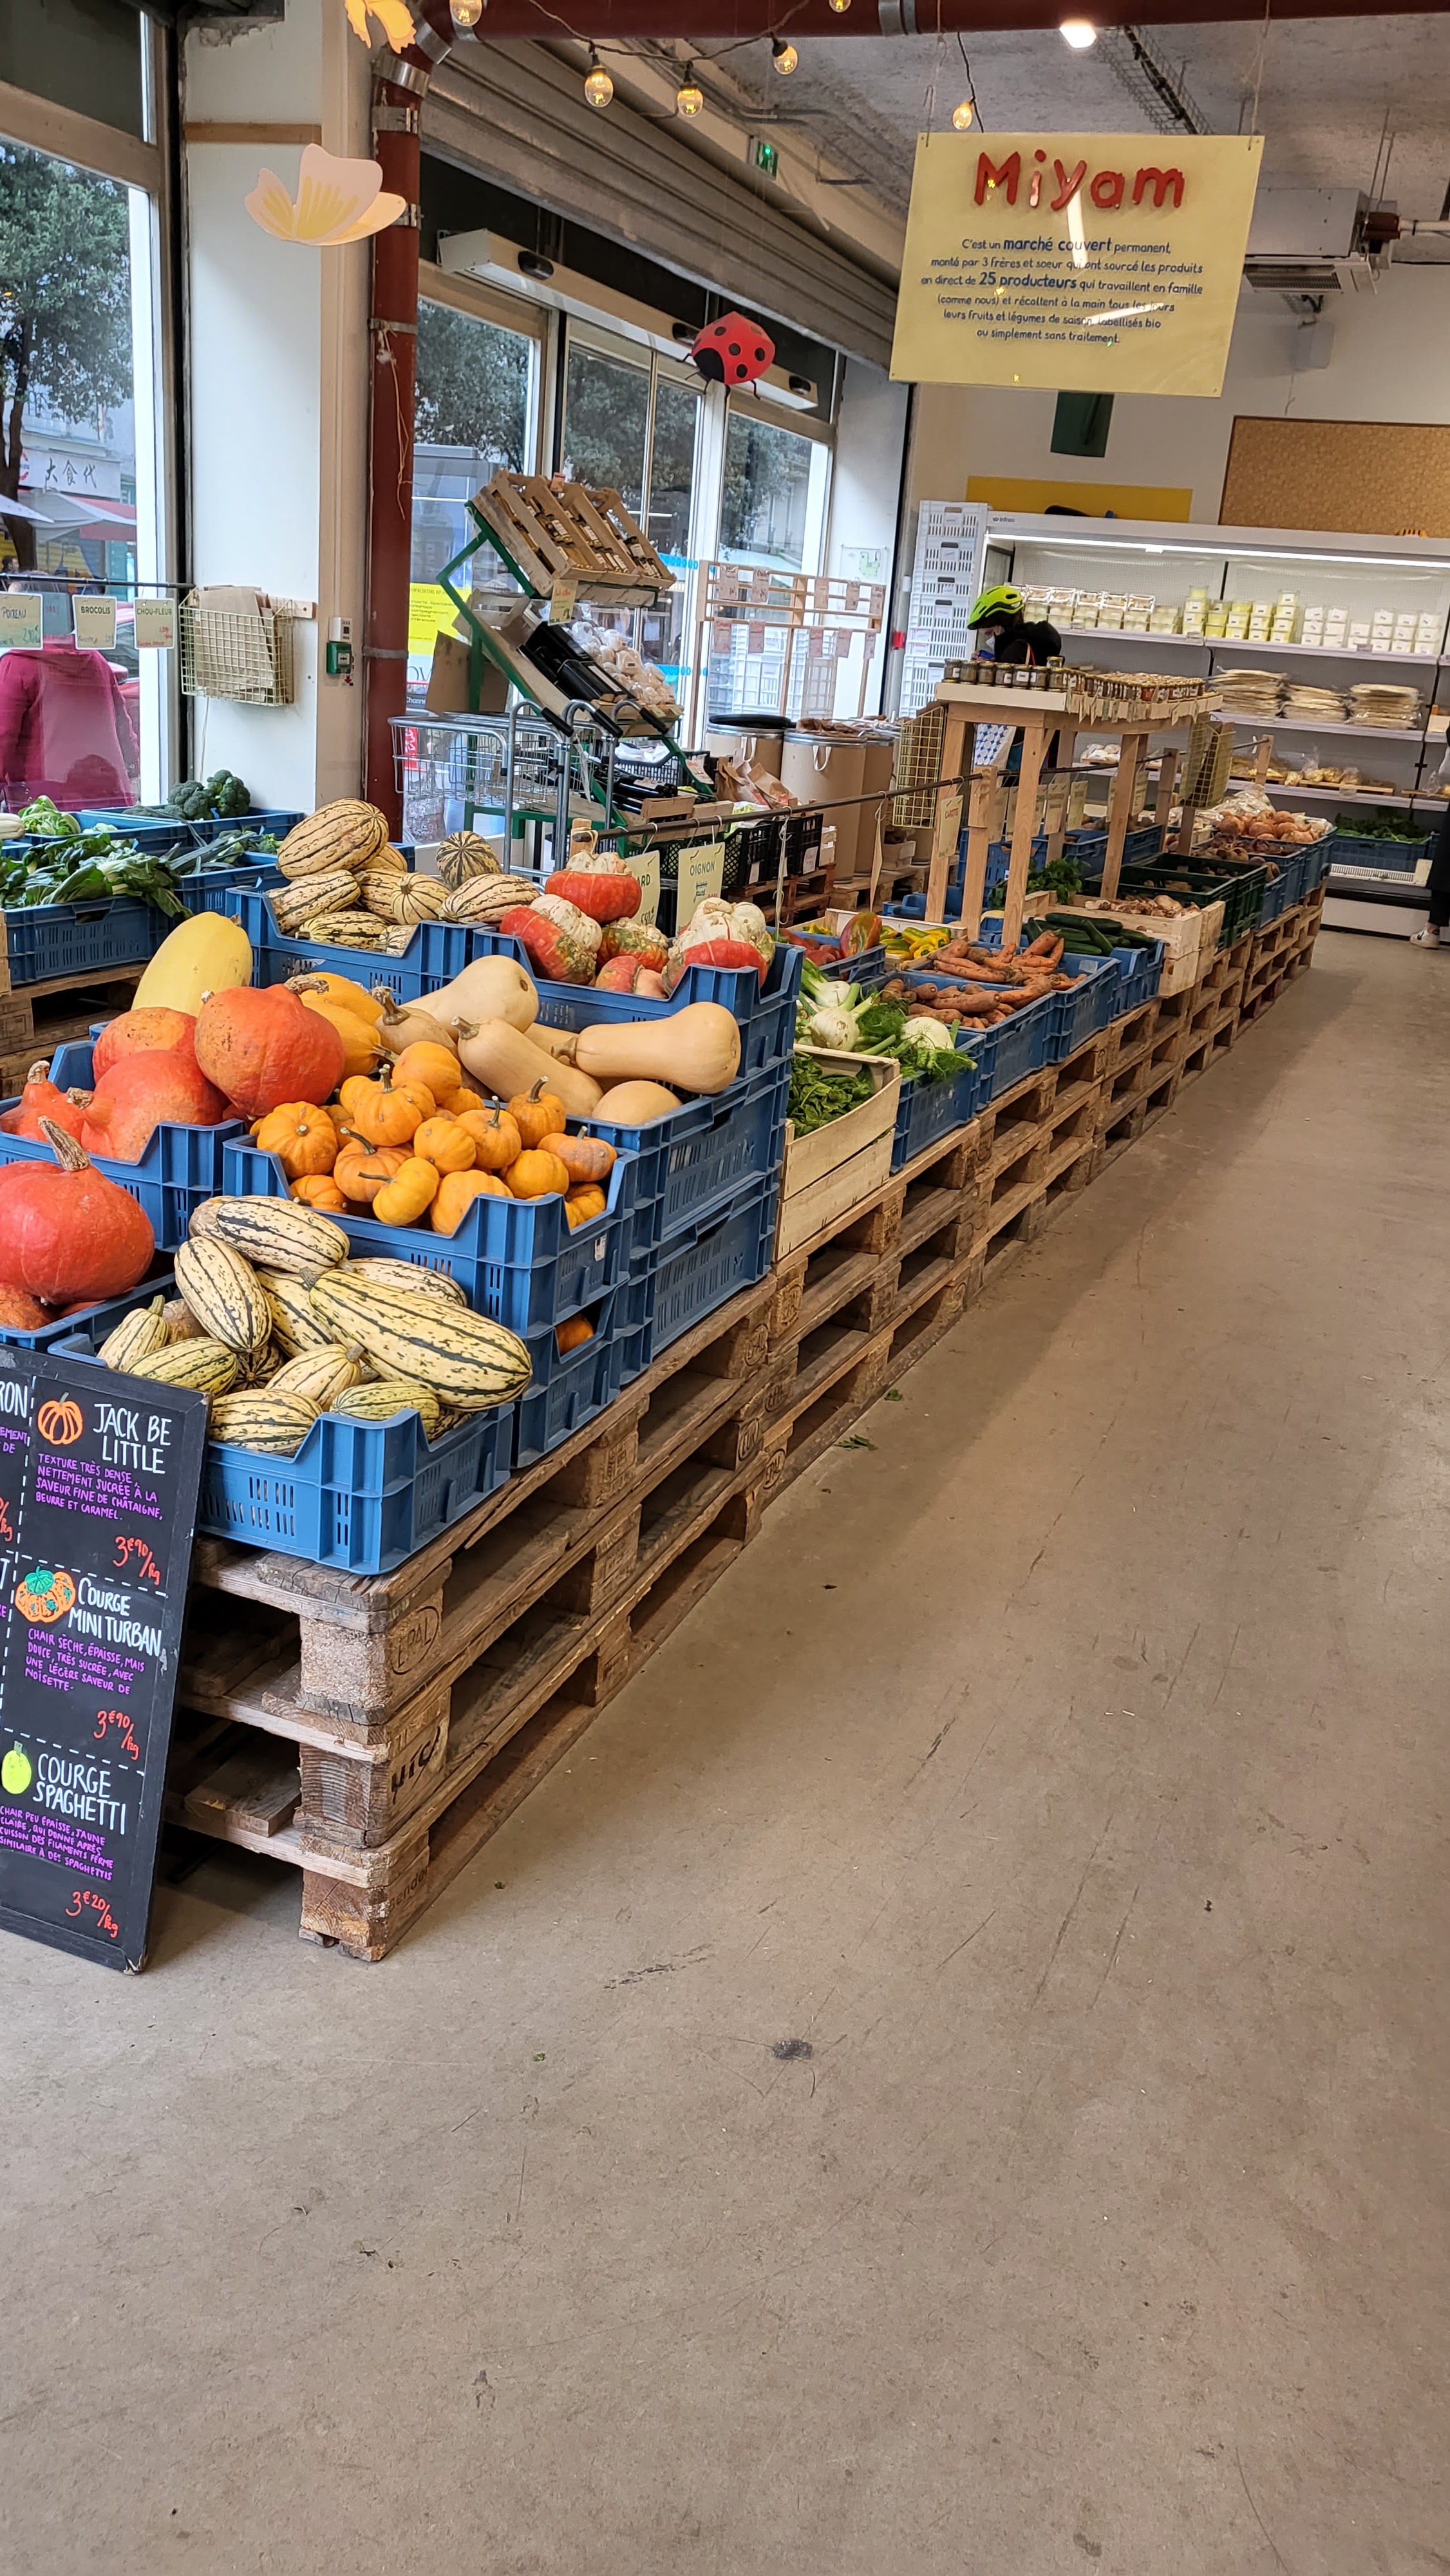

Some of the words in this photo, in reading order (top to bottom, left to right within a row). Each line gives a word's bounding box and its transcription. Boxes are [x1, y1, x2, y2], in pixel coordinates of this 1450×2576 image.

[973, 149, 1185, 211] Miyam
[962, 238, 986, 249] C'est
[1003, 236, 1053, 251] marché
[1058, 237, 1112, 251] couvert
[931, 256, 959, 267] monté
[962, 260, 979, 269] par
[982, 258, 988, 267] 3
[991, 257, 1021, 269] frères
[1023, 258, 1034, 268] et
[1036, 261, 1063, 269] soeur
[1066, 259, 1082, 271] qui
[1084, 259, 1101, 270] ont
[1104, 261, 1138, 272] sourcé
[1141, 261, 1156, 272] les
[1158, 263, 1203, 275] produits
[935, 274, 963, 285] direct
[965, 276, 976, 285] de
[979, 272, 997, 285] 25
[999, 274, 1077, 289] producteurs
[1079, 279, 1095, 292] qui
[1098, 280, 1150, 292] travaillent
[1168, 282, 1203, 294] famille
[937, 294, 972, 305] (comme
[974, 294, 999, 306] nous)
[1002, 296, 1012, 305] et
[1014, 296, 1059, 307] récoltent
[1061, 298, 1068, 307] à
[1070, 297, 1080, 307] la
[1082, 299, 1106, 308] main
[1109, 299, 1129, 309] tous
[1133, 299, 1146, 310] les
[1151, 301, 1175, 312] jours
[943, 309, 966, 319] leurs
[968, 310, 993, 321] fruits
[996, 310, 1005, 321] et
[1008, 311, 1046, 324] légumes
[1048, 314, 1060, 323] de
[1097, 315, 1143, 327] labellisés
[1145, 317, 1162, 328] bio
[991, 328, 1042, 341] simplement
[1045, 332, 1066, 340] sans
[1069, 332, 1120, 343] traitement.
[80, 605, 111, 614] BROCOLIS
[690, 860, 715, 876] OIGNON
[93, 1403, 139, 1442] JACK
[147, 1415, 173, 1446] BE
[3, 1442, 15, 1454] DE
[38, 1453, 78, 1470] TEXTURE
[80, 1460, 100, 1476] TRÈS
[102, 1439, 166, 1475] LITTLE
[35, 1477, 71, 1497] SAVEUR
[73, 1487, 96, 1502] FINE
[97, 1493, 108, 1504] DE
[111, 1496, 163, 1520] CHÂTAIGNE,
[37, 1464, 93, 1488] NETTEMENT
[96, 1479, 131, 1497] SUCRÉE
[134, 1485, 142, 1499] À
[145, 1490, 158, 1503] LA
[35, 1492, 65, 1508] BEURRE
[68, 1499, 79, 1511] ET
[81, 1503, 123, 1520] CARAMEL.
[77, 1576, 132, 1618] COURGE
[28, 1627, 55, 1646] CHAIR
[124, 1657, 145, 1672] MAIS
[68, 1605, 102, 1640] MINI
[103, 1615, 162, 1658] TURBAN
[26, 1656, 43, 1670] UNE
[49, 1662, 79, 1680] LÉGÈRE
[81, 1673, 114, 1691] SAVEUR
[118, 1683, 131, 1695] DE
[56, 1651, 76, 1667] TRÈS
[112, 1668, 135, 1682] AVEC
[38, 1753, 111, 1799] COURGE
[0, 1805, 23, 1819] CHAIR
[25, 1811, 39, 1823] PEU
[75, 1828, 106, 1846] JAUNE
[32, 1781, 126, 1835] SPAGHETTI
[0, 1826, 29, 1841] CUISSON
[32, 1834, 46, 1846] DES
[48, 1839, 88, 1860] FILAMENTS
[90, 1854, 114, 1870] FERME
[0, 1836, 37, 1855] SIMILAIRE
[39, 1847, 46, 1859] À
[48, 1850, 62, 1863] DES
[64, 1857, 113, 1881] SPAGHETTIS
[32, 1824, 46, 1837] QUI
[48, 1828, 75, 1846] DONNE
[77, 1840, 102, 1857] APRÈS
